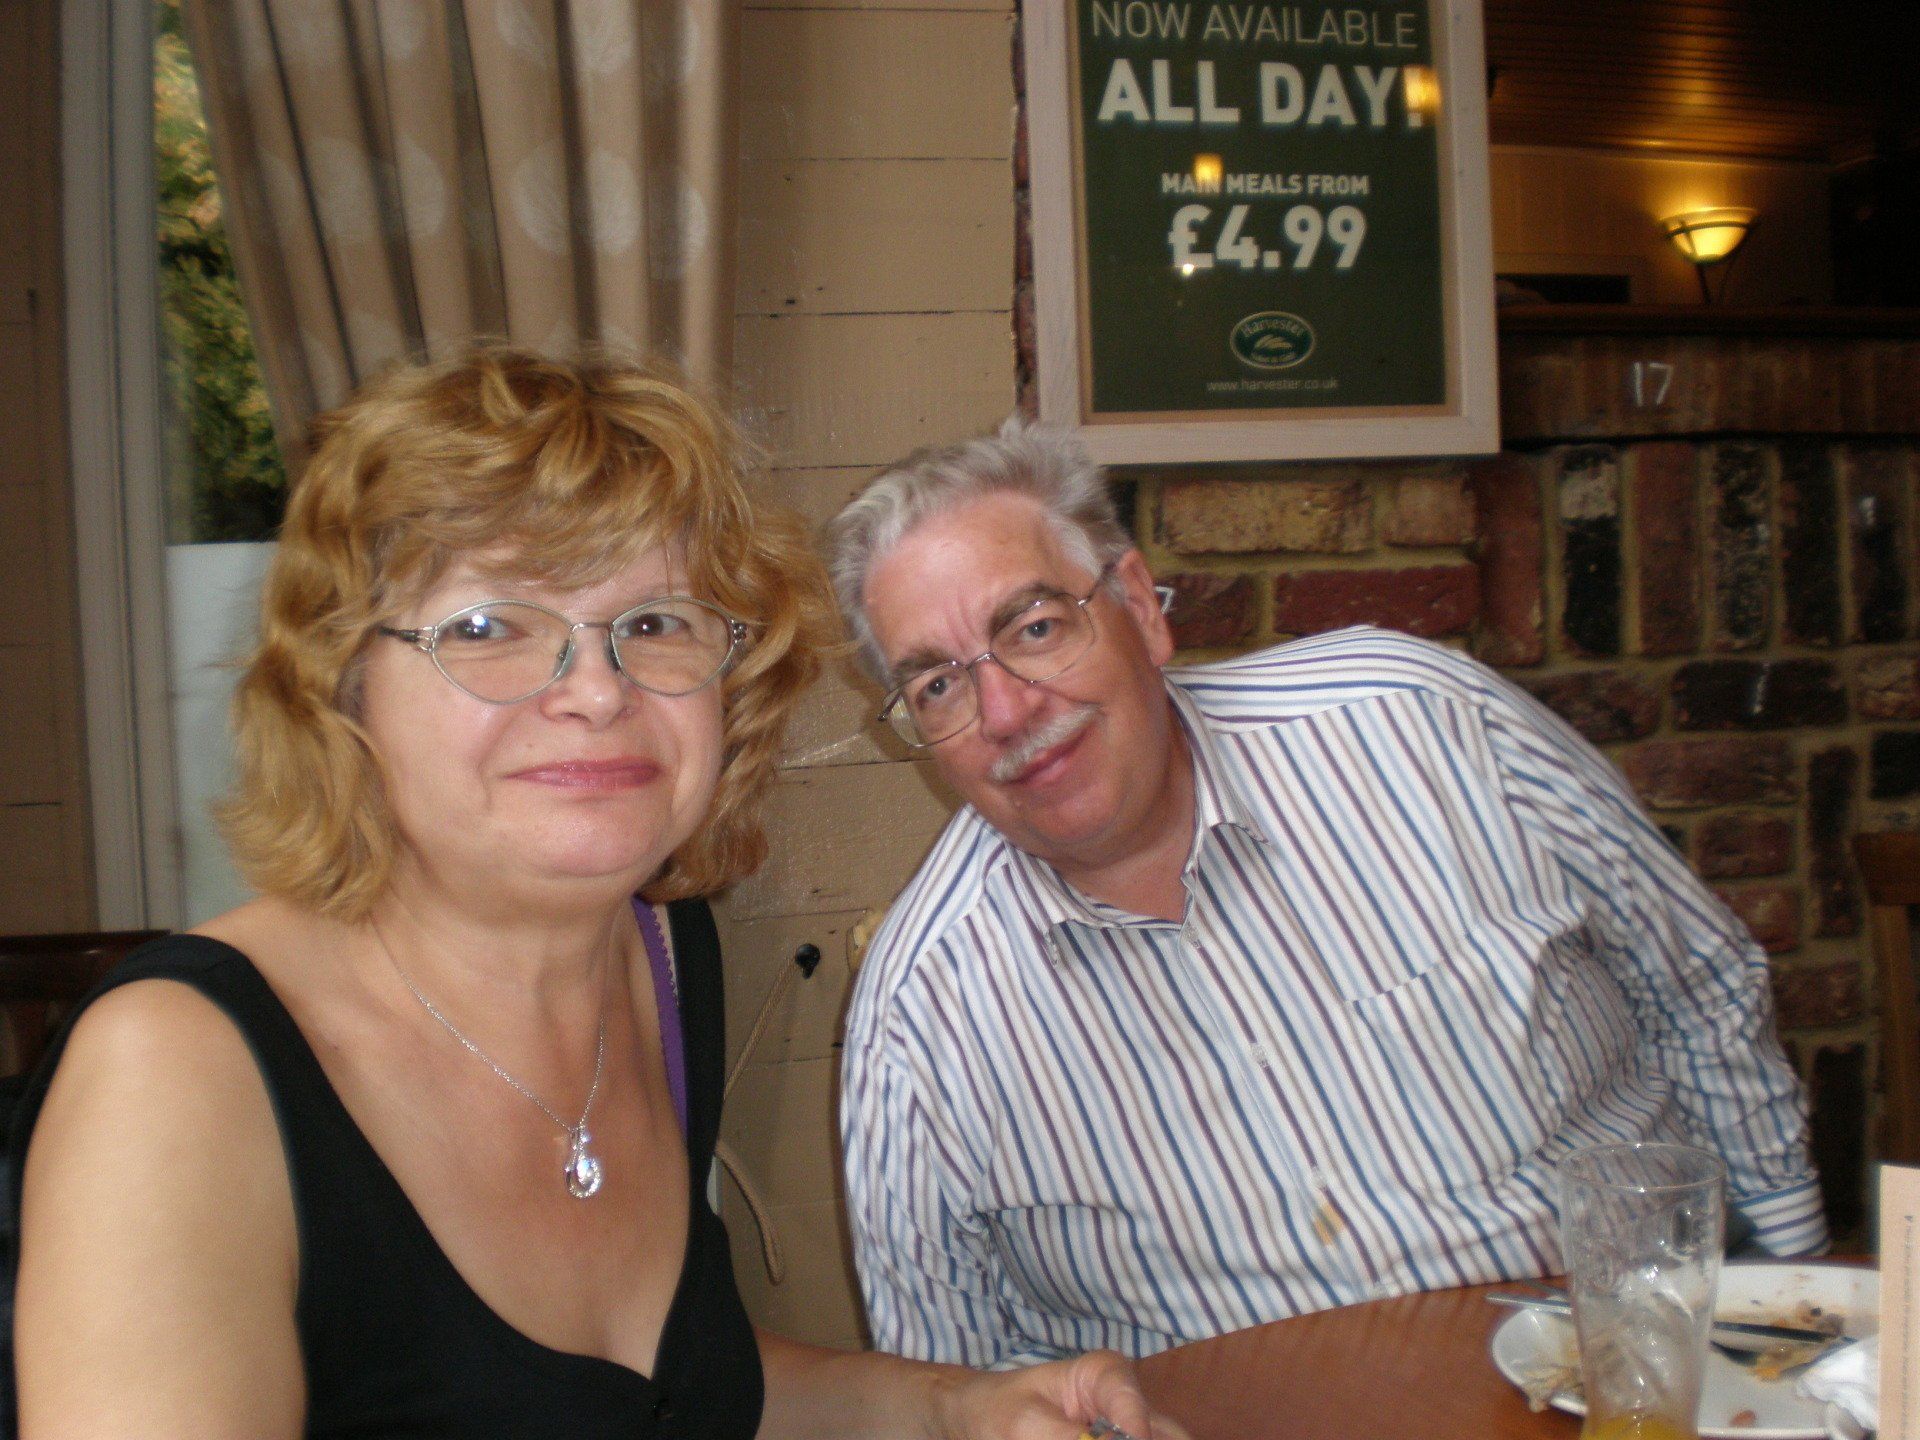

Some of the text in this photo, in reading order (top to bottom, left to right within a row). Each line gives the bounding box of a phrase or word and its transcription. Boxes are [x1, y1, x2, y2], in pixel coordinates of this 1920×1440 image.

[1092, 0, 1418, 48] NOW AVAILABLE
[1098, 57, 1240, 122] ALL
[1161, 172, 1370, 195] MAIN MEALS FROM
[1167, 203, 1367, 268] £4.99
[1633, 362, 1674, 407] 17
